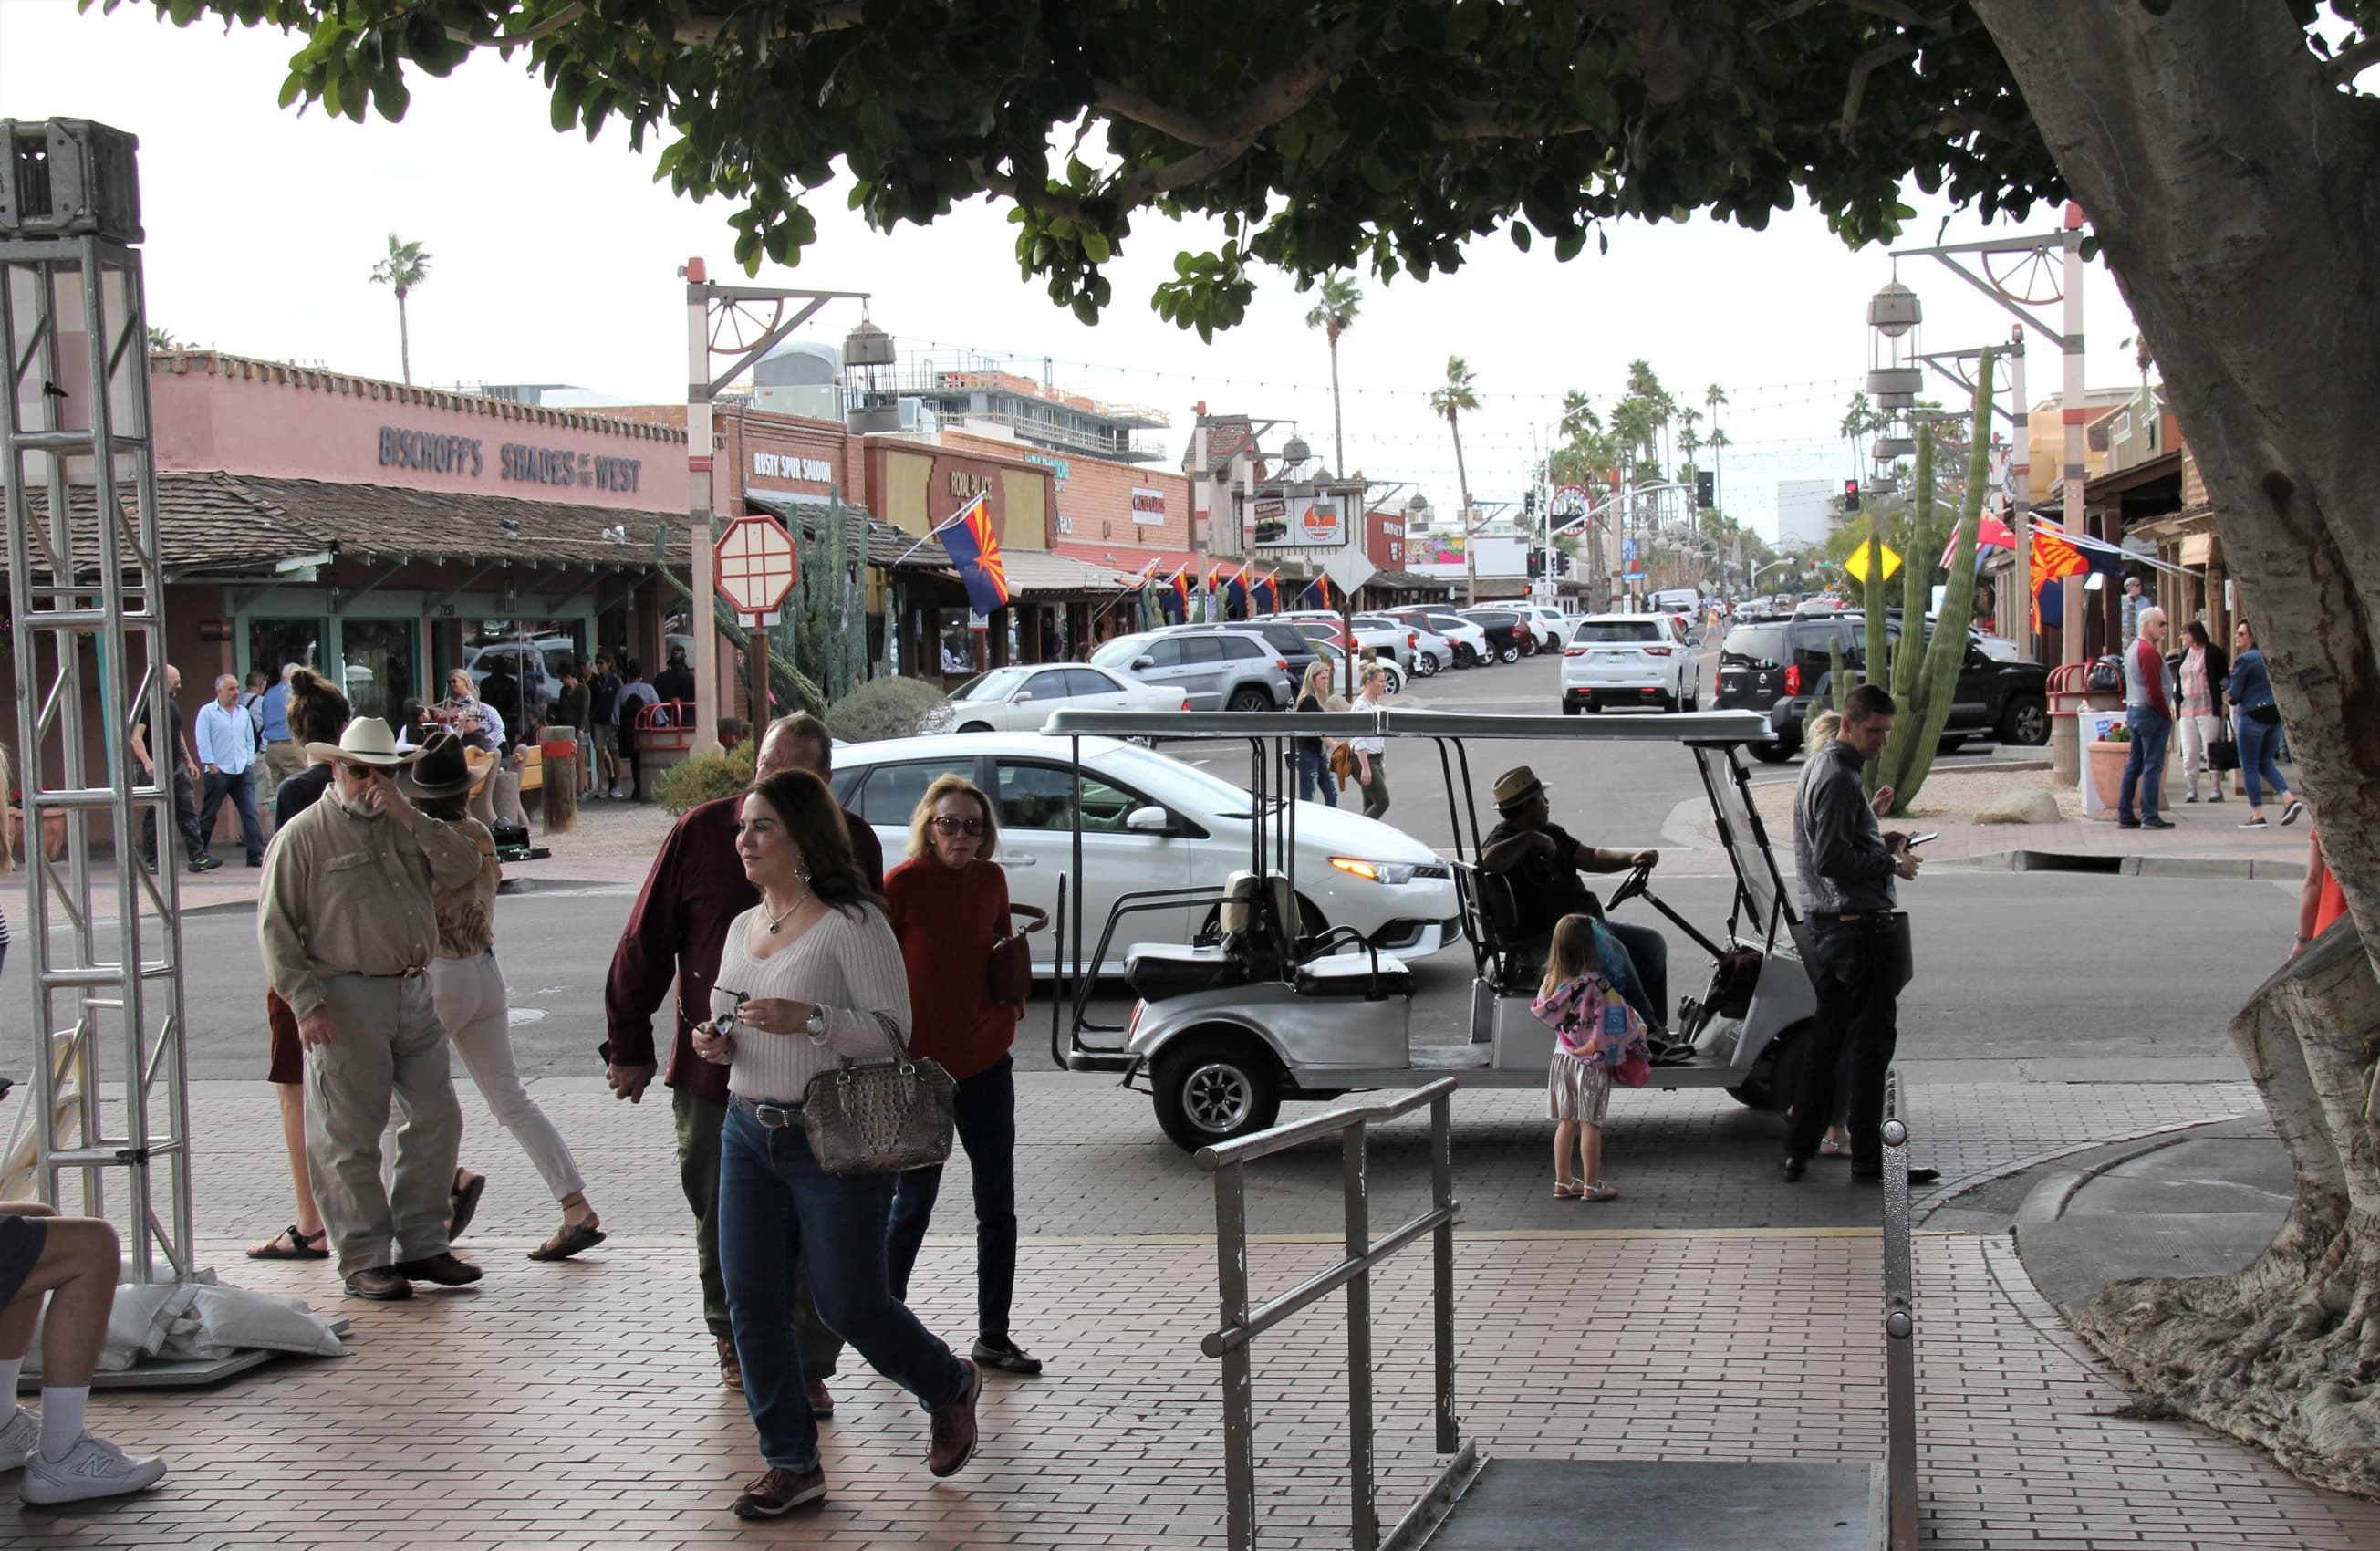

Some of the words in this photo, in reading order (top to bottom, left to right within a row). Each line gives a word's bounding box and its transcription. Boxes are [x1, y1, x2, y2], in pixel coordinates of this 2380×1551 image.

[379, 426, 483, 475] BISCHOFF'S
[501, 443, 576, 485] SHADES
[577, 453, 590, 468] OF
[577, 471, 593, 488] THE
[594, 455, 641, 493] WEST
[753, 453, 779, 476] RUSTY
[781, 456, 801, 479] SPUR
[802, 459, 831, 483] SALOON
[951, 471, 970, 498] ROYAL
[971, 474, 992, 501] PALACE
